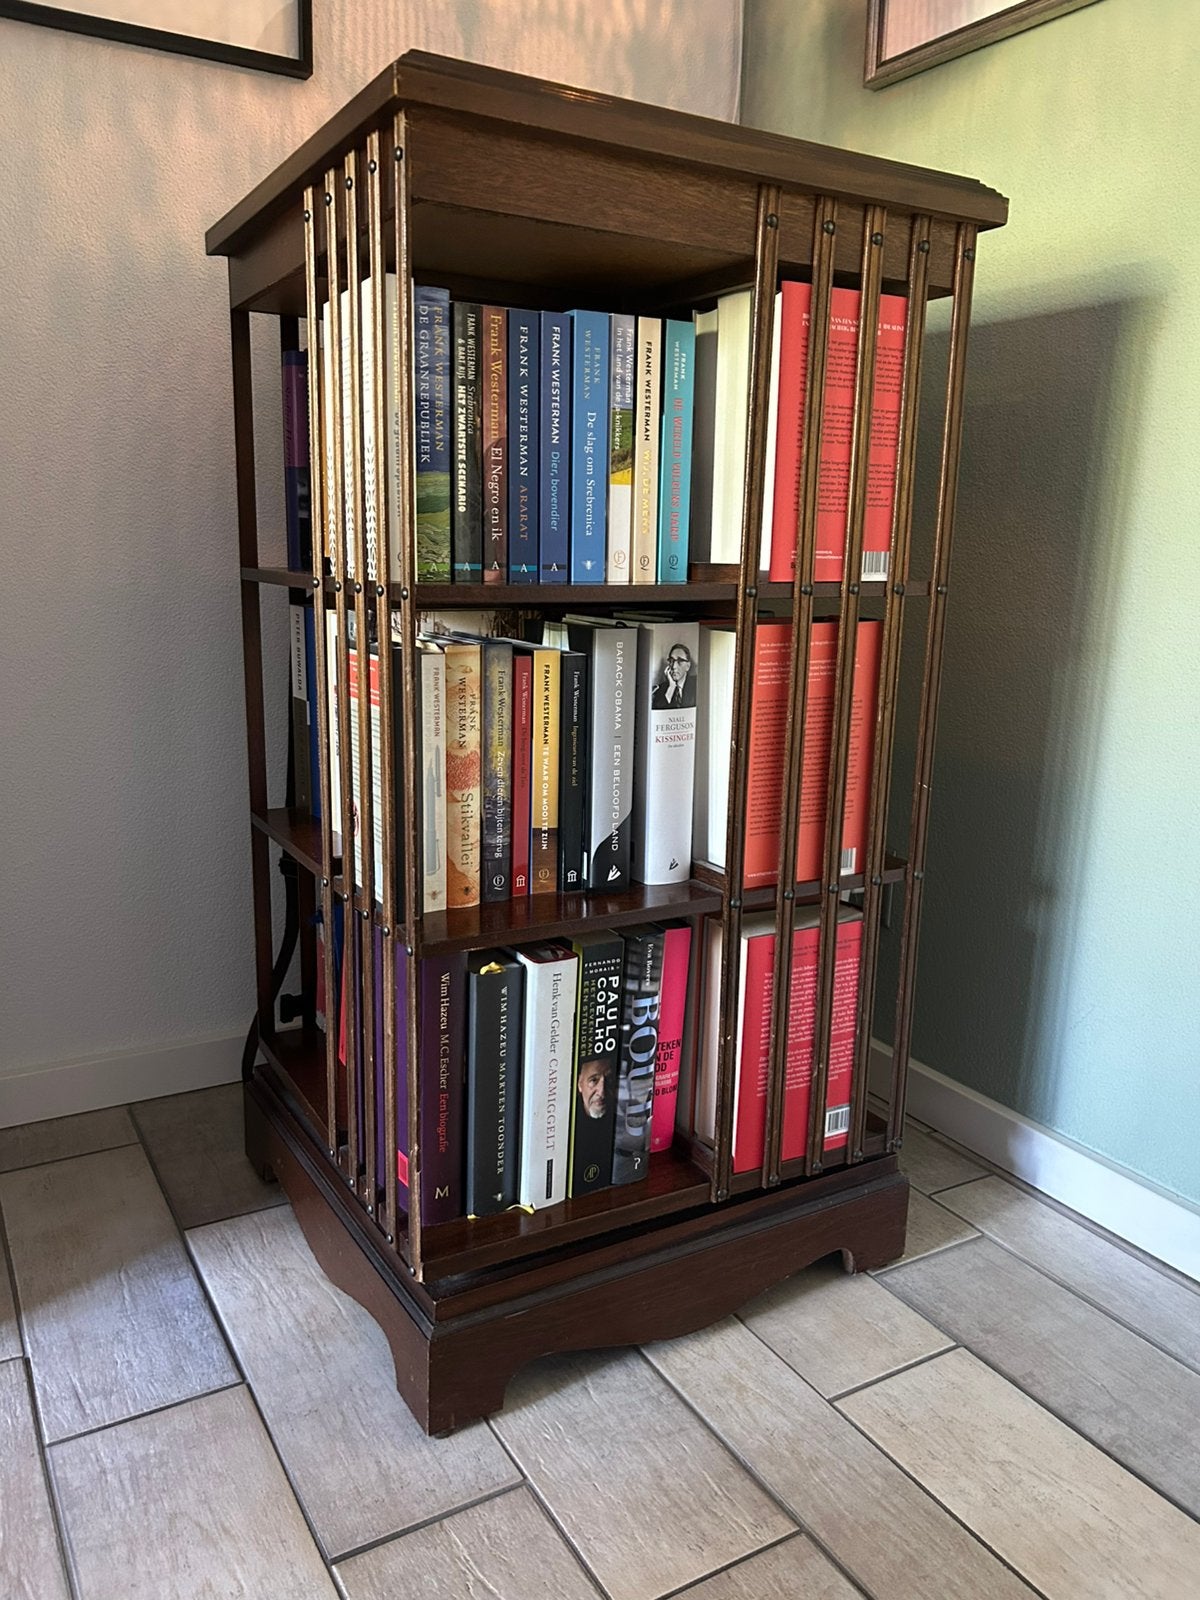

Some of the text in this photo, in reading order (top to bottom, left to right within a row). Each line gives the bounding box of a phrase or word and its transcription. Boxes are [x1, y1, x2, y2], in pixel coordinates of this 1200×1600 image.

[457, 366, 466, 380] RIJS
[458, 346, 466, 364] BART
[466, 314, 476, 434] FRANK WESTERMAN Srebrenica
[583, 330, 592, 400] WESTERMAN
[592, 346, 602, 384] FRANK
[624, 328, 634, 403] Frank Westerman
[645, 341, 653, 376] FRANK
[418, 306, 431, 464] DE GRAANREPUBLIEK
[433, 307, 445, 452] FRANK WESTERMAN
[458, 386, 466, 405] HET
[612, 327, 624, 450] In het land van de ja-knikkers
[490, 314, 503, 541] Frank Westerman El Negro en ik
[644, 380, 652, 442] WESTERMAN
[674, 398, 682, 410] DE
[458, 407, 466, 460] ZWARTSTE
[519, 326, 529, 542] FRANK WESTERMAN ARARAT
[549, 326, 561, 532] FRANK WESTERMAN Dier, bovendier
[672, 416, 683, 458] WERELD
[458, 462, 466, 512] SCENARIO
[584, 412, 597, 536] De slag om Srebrenica
[642, 478, 651, 495] DE
[671, 464, 682, 508] VOLGENS
[642, 498, 650, 534] MENS
[433, 667, 442, 736] FRANK WESTERMAN
[520, 672, 529, 690] Frank
[572, 671, 581, 688] Frank
[458, 677, 467, 748] WESTERMAN
[469, 694, 478, 732] FRANK
[520, 692, 529, 724] Westerman
[572, 690, 580, 722] Westerman
[656, 722, 694, 732] FERGUSON
[540, 664, 551, 850] FRANK WESTERMAN TE WAAR OM MOOI TE ZIJN
[570, 725, 579, 756] Ingenieurs
[610, 642, 624, 851] BARACK OBAMA EEN BELOOFD LAND
[656, 733, 694, 743] KISSINGER
[494, 670, 506, 858] Frank Westerman Zeven dieren bijten terug
[572, 768, 578, 776] de
[460, 793, 475, 866] Stikvallei
[552, 973, 562, 1000] Henk
[584, 958, 621, 968] FERNANDO
[645, 943, 654, 987] Eva Rovers
[550, 1020, 560, 1054] Gelder
[580, 981, 590, 1057] EEN STRIJDER
[588, 1002, 596, 1034] LEVEN
[594, 977, 606, 1054] COELHO
[604, 976, 620, 1052] PAULO
[437, 972, 450, 1152] Wim Hazeu M.C. Escher Een biografie
[664, 1051, 674, 1061] DE
[496, 986, 508, 1174] WIM HAZEU MARTEN TOONDER
[546, 1058, 558, 1150] CARMIGGELT
